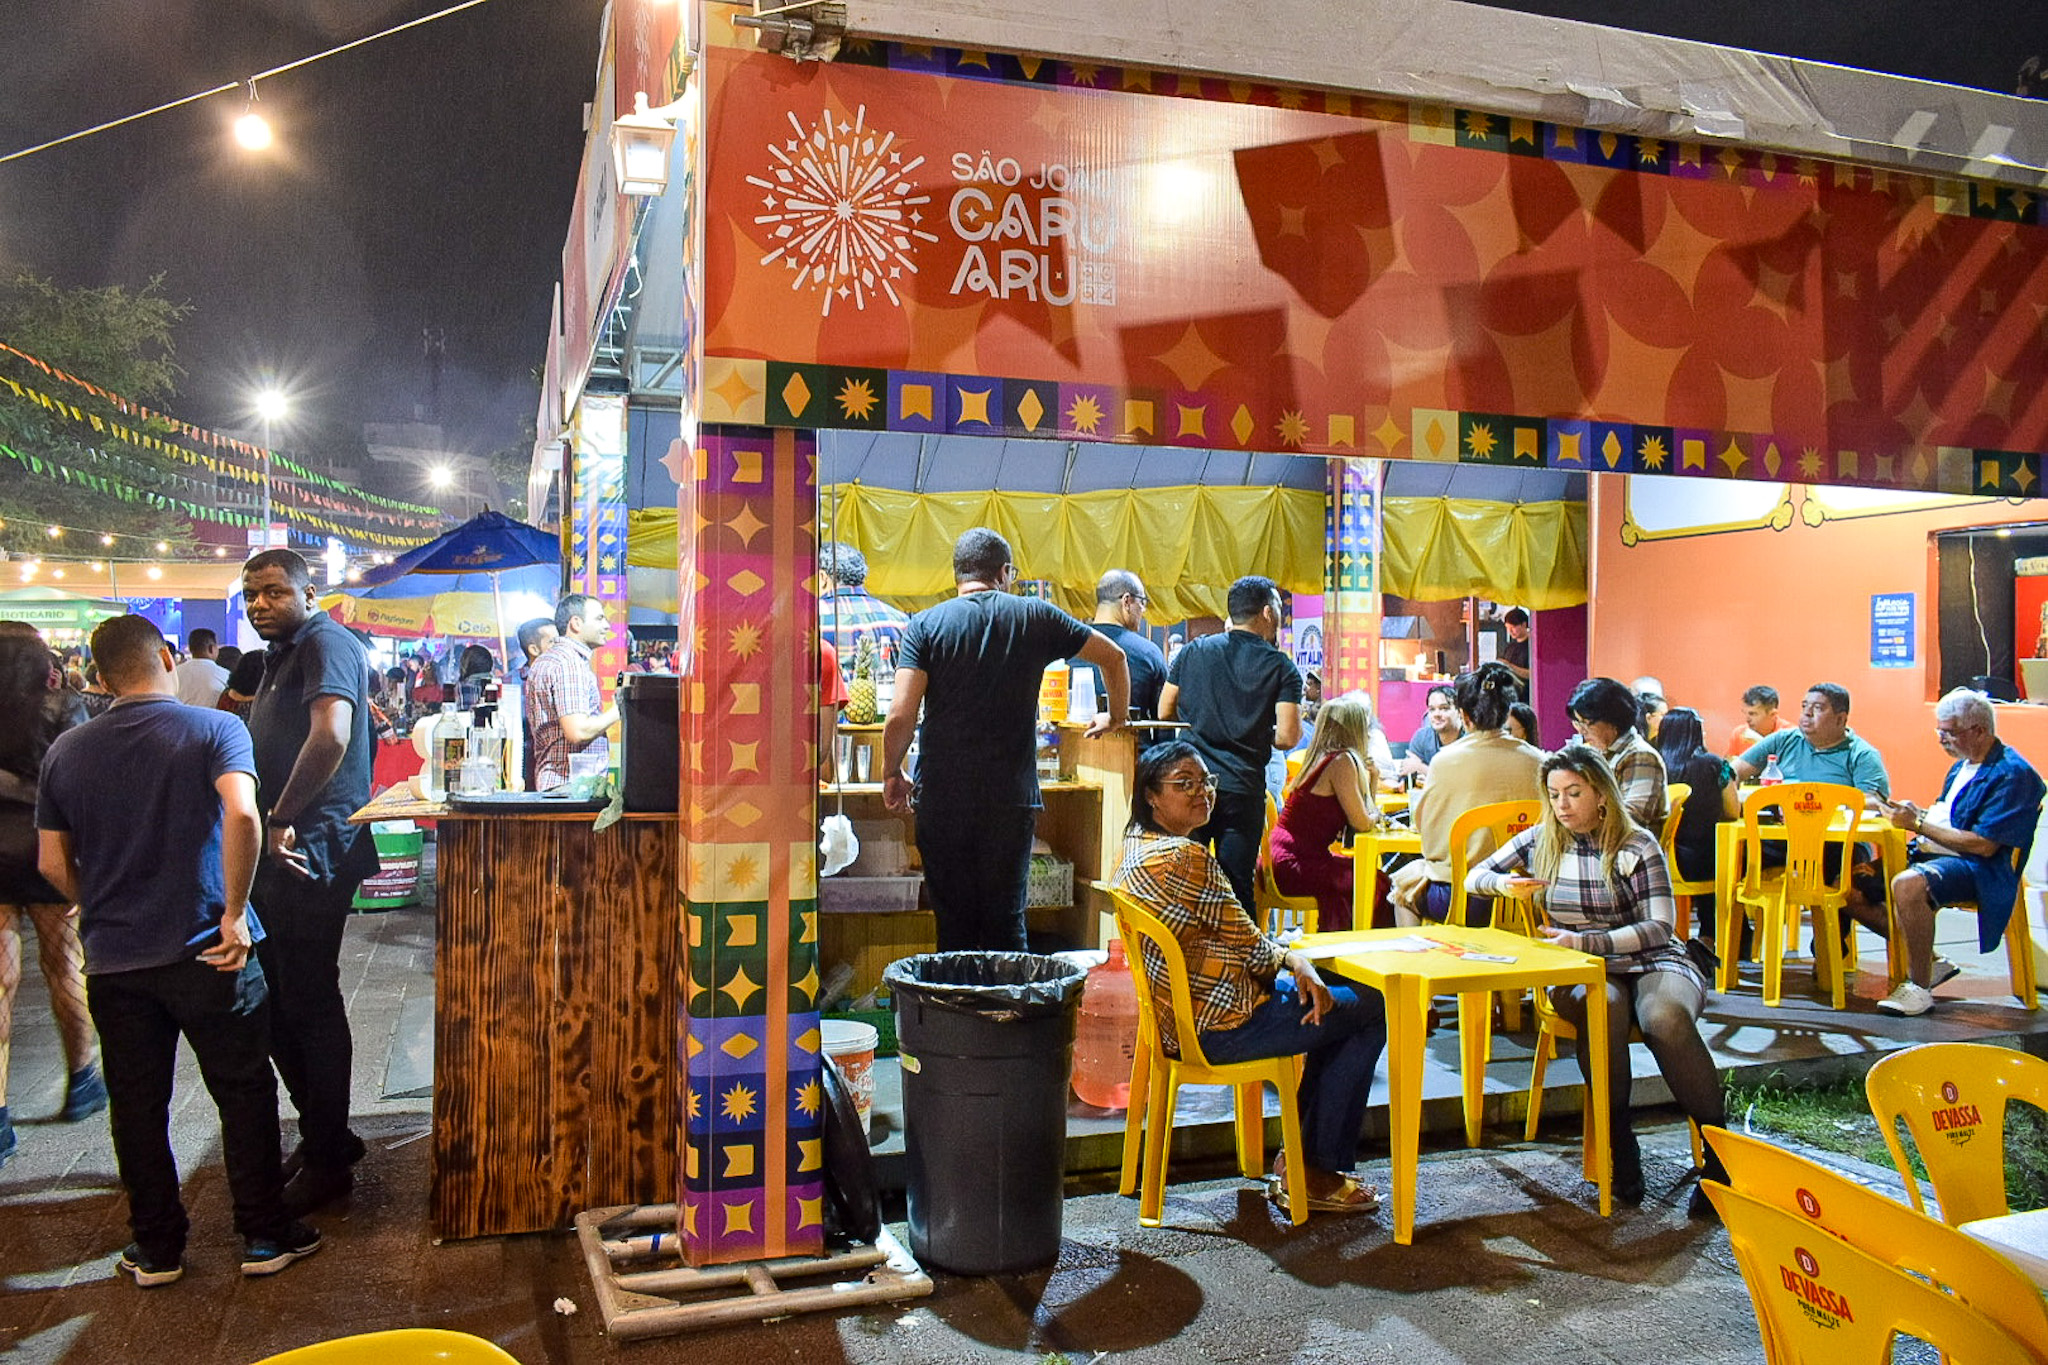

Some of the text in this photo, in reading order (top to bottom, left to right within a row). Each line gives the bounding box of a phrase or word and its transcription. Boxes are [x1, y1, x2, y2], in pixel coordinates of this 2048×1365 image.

[951, 149, 1115, 197] SÃO JOÃO
[949, 187, 1116, 254] CARU
[949, 244, 1077, 307] ARU
[1931, 1104, 1982, 1132] DEVASSA
[1779, 1264, 1855, 1324] DEVASSA
